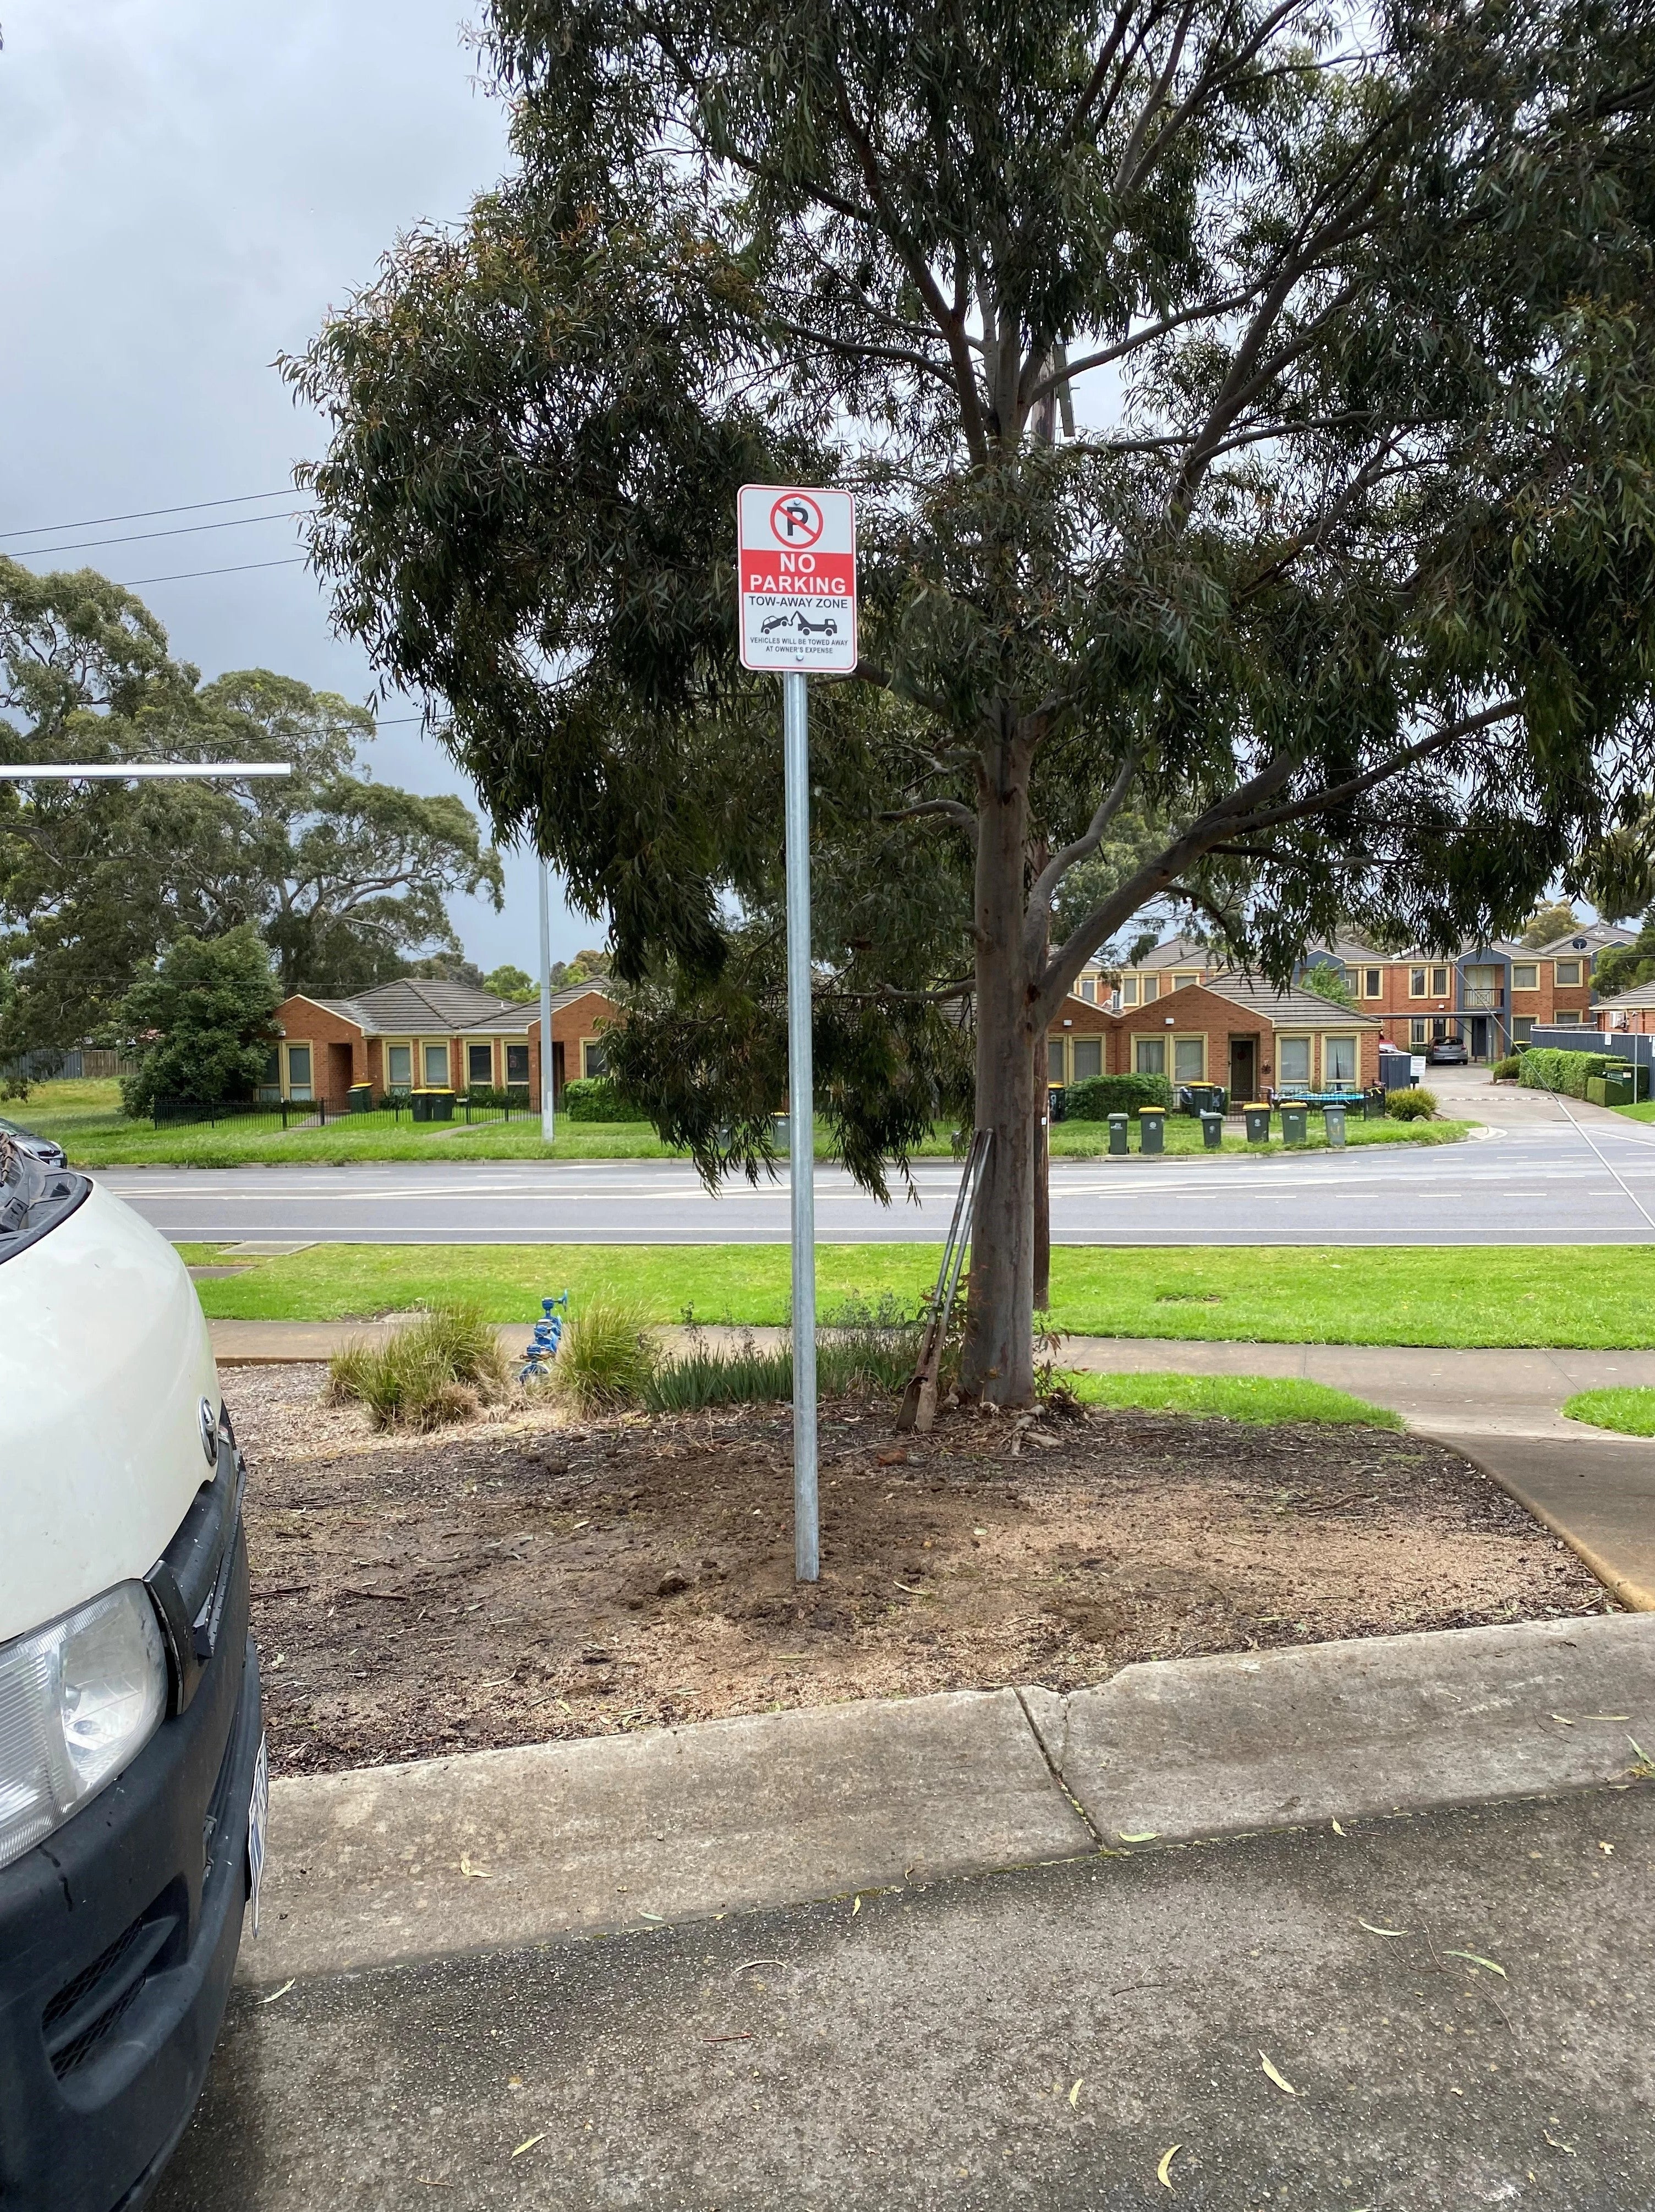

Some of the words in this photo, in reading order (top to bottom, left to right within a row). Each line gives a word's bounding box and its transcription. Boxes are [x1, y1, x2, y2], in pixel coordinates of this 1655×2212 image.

[787, 507, 808, 536] P
[780, 553, 815, 573] NO
[750, 574, 845, 594] PARKING
[749, 596, 813, 607] TOW-AWAY
[816, 598, 848, 608] ZONE
